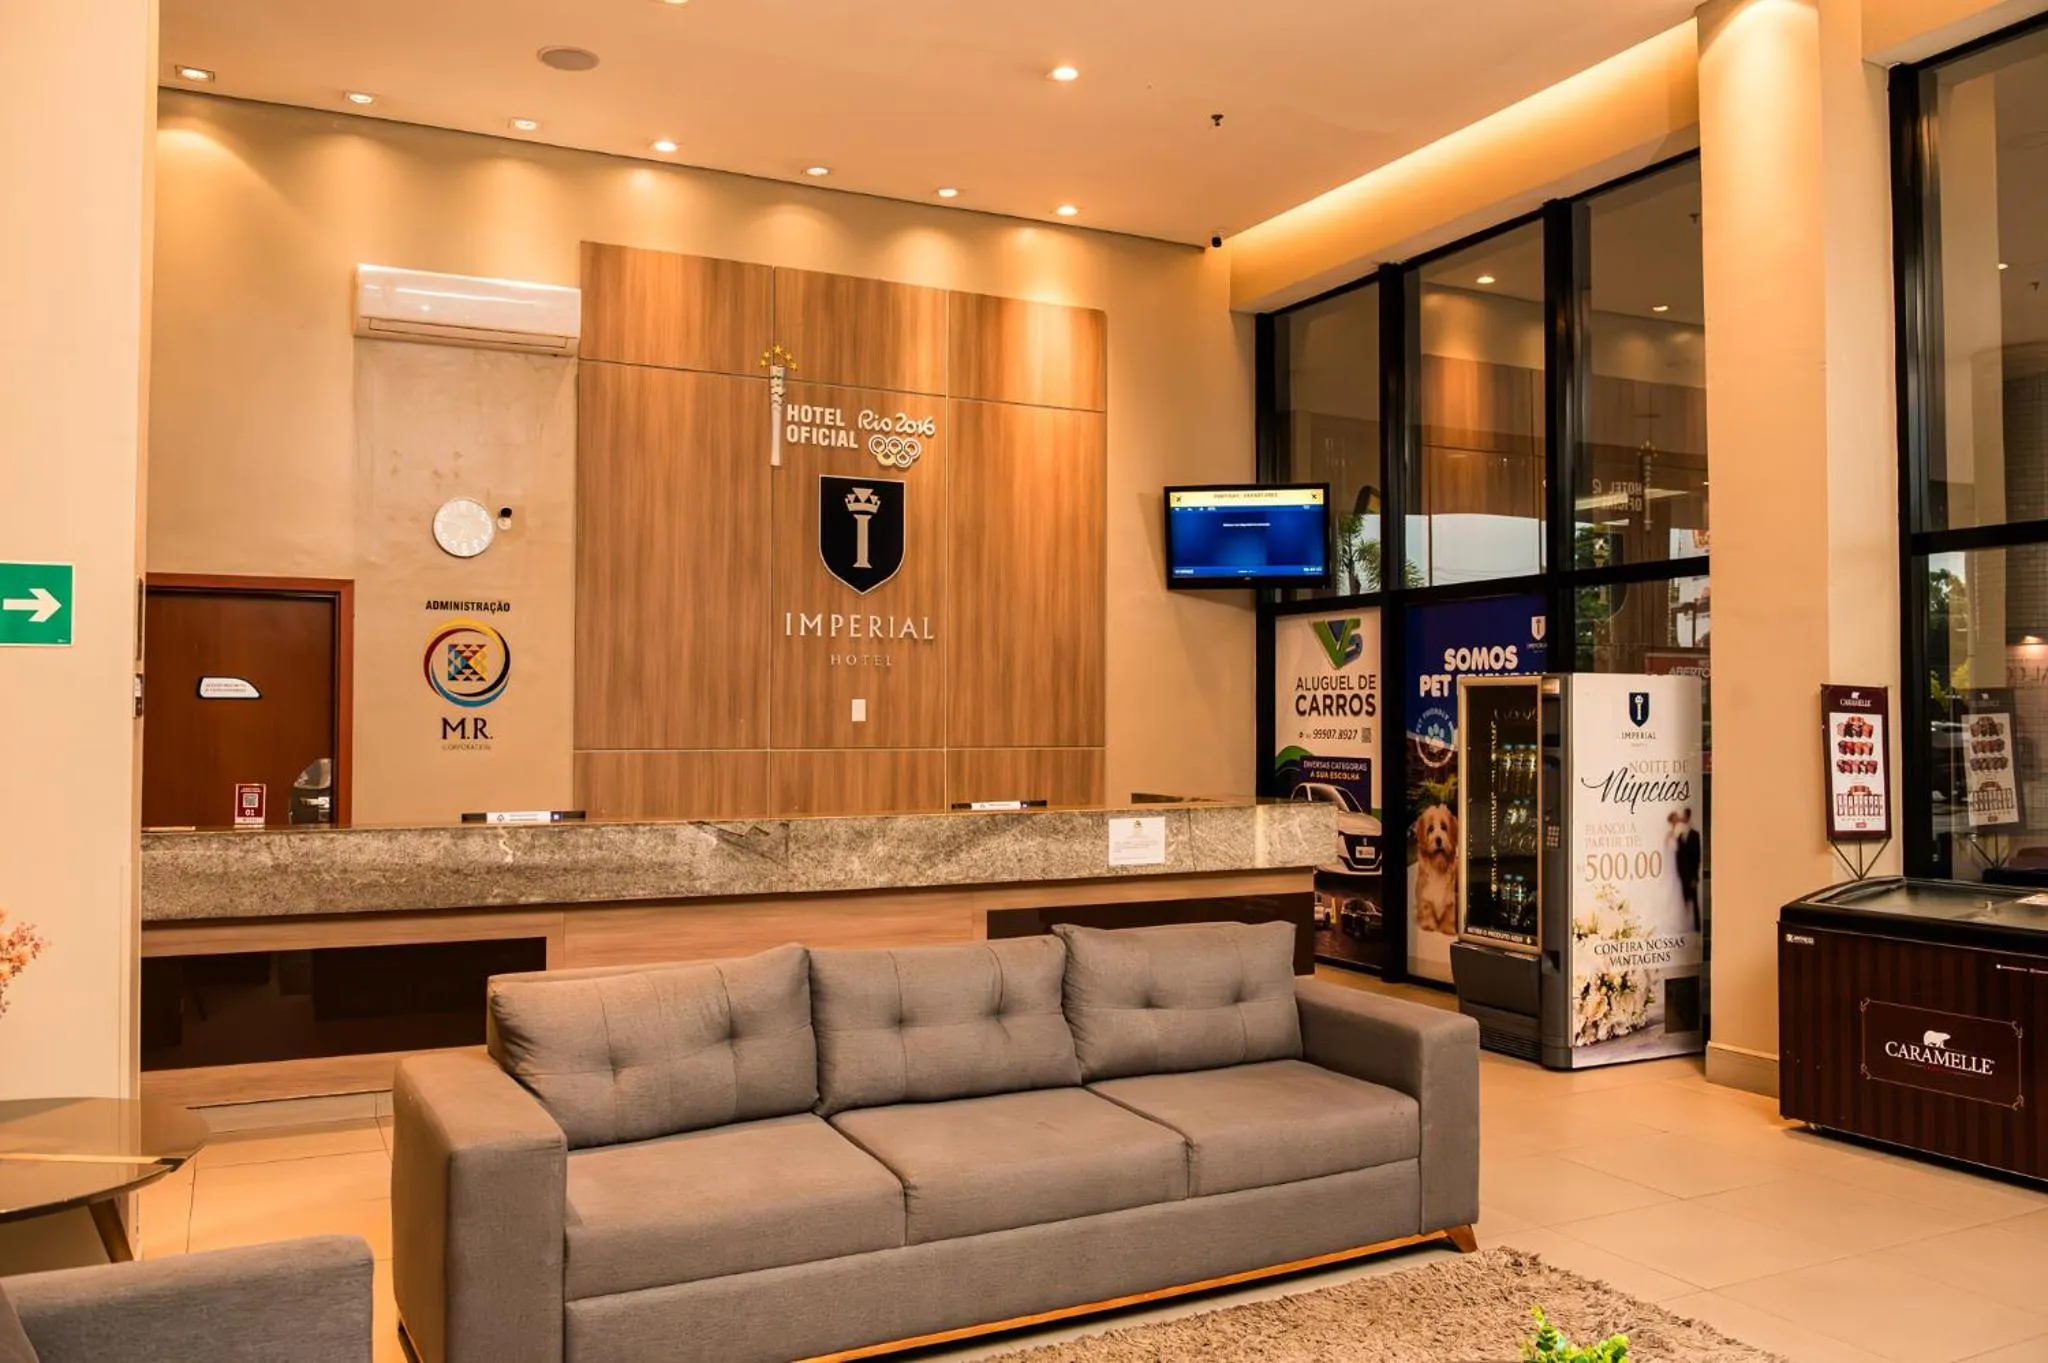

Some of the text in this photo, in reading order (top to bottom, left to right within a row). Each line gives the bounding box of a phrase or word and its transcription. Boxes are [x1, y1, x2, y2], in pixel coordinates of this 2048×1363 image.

[786, 403, 936, 437] HOTEL Rio 2016
[786, 424, 858, 449] OFICIAL
[425, 600, 511, 614] ADMINISTRAÇÃO
[785, 612, 935, 641] IMPERIAL
[830, 654, 893, 667] HOTEL
[1444, 645, 1518, 671] SOMOS
[1295, 674, 1377, 691] ALUGUEL DE
[1419, 674, 1452, 698] PET
[1295, 693, 1377, 717] CARROS
[441, 717, 494, 740] M.R.
[1621, 732, 1656, 740] IMPERIAL
[1628, 759, 1689, 774] NOITE DE
[1594, 936, 1686, 955] CONFIRA NOSSAS
[1609, 952, 1671, 966] VANTAGENS
[1884, 1041, 1995, 1075] CARAMELLE
